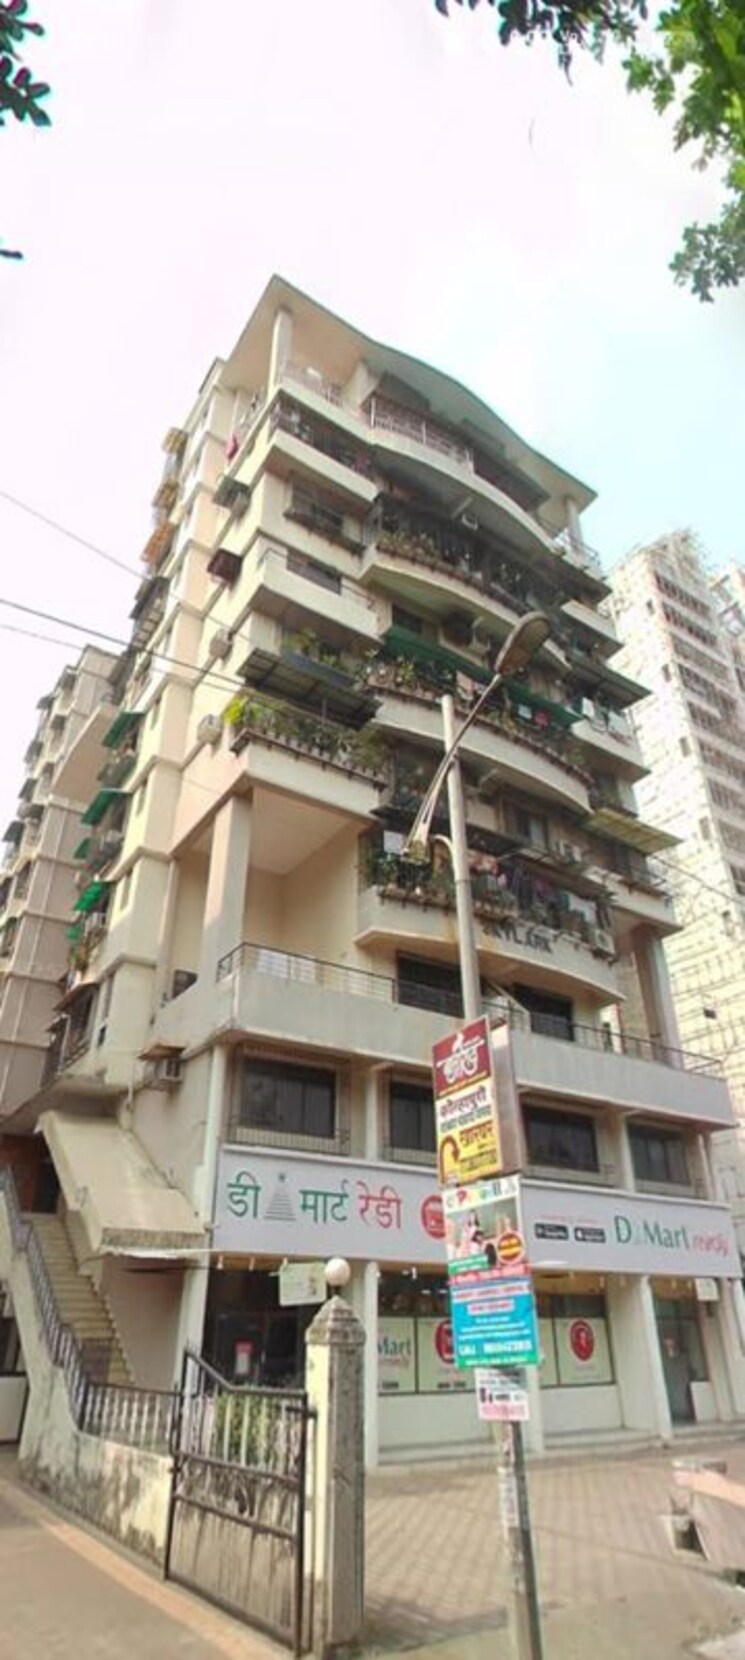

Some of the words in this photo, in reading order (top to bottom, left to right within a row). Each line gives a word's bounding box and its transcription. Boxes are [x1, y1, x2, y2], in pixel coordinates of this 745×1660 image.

[227, 1171, 261, 1219] डी
[299, 1179, 349, 1224] मार्ट
[356, 1180, 402, 1229] रेडी
